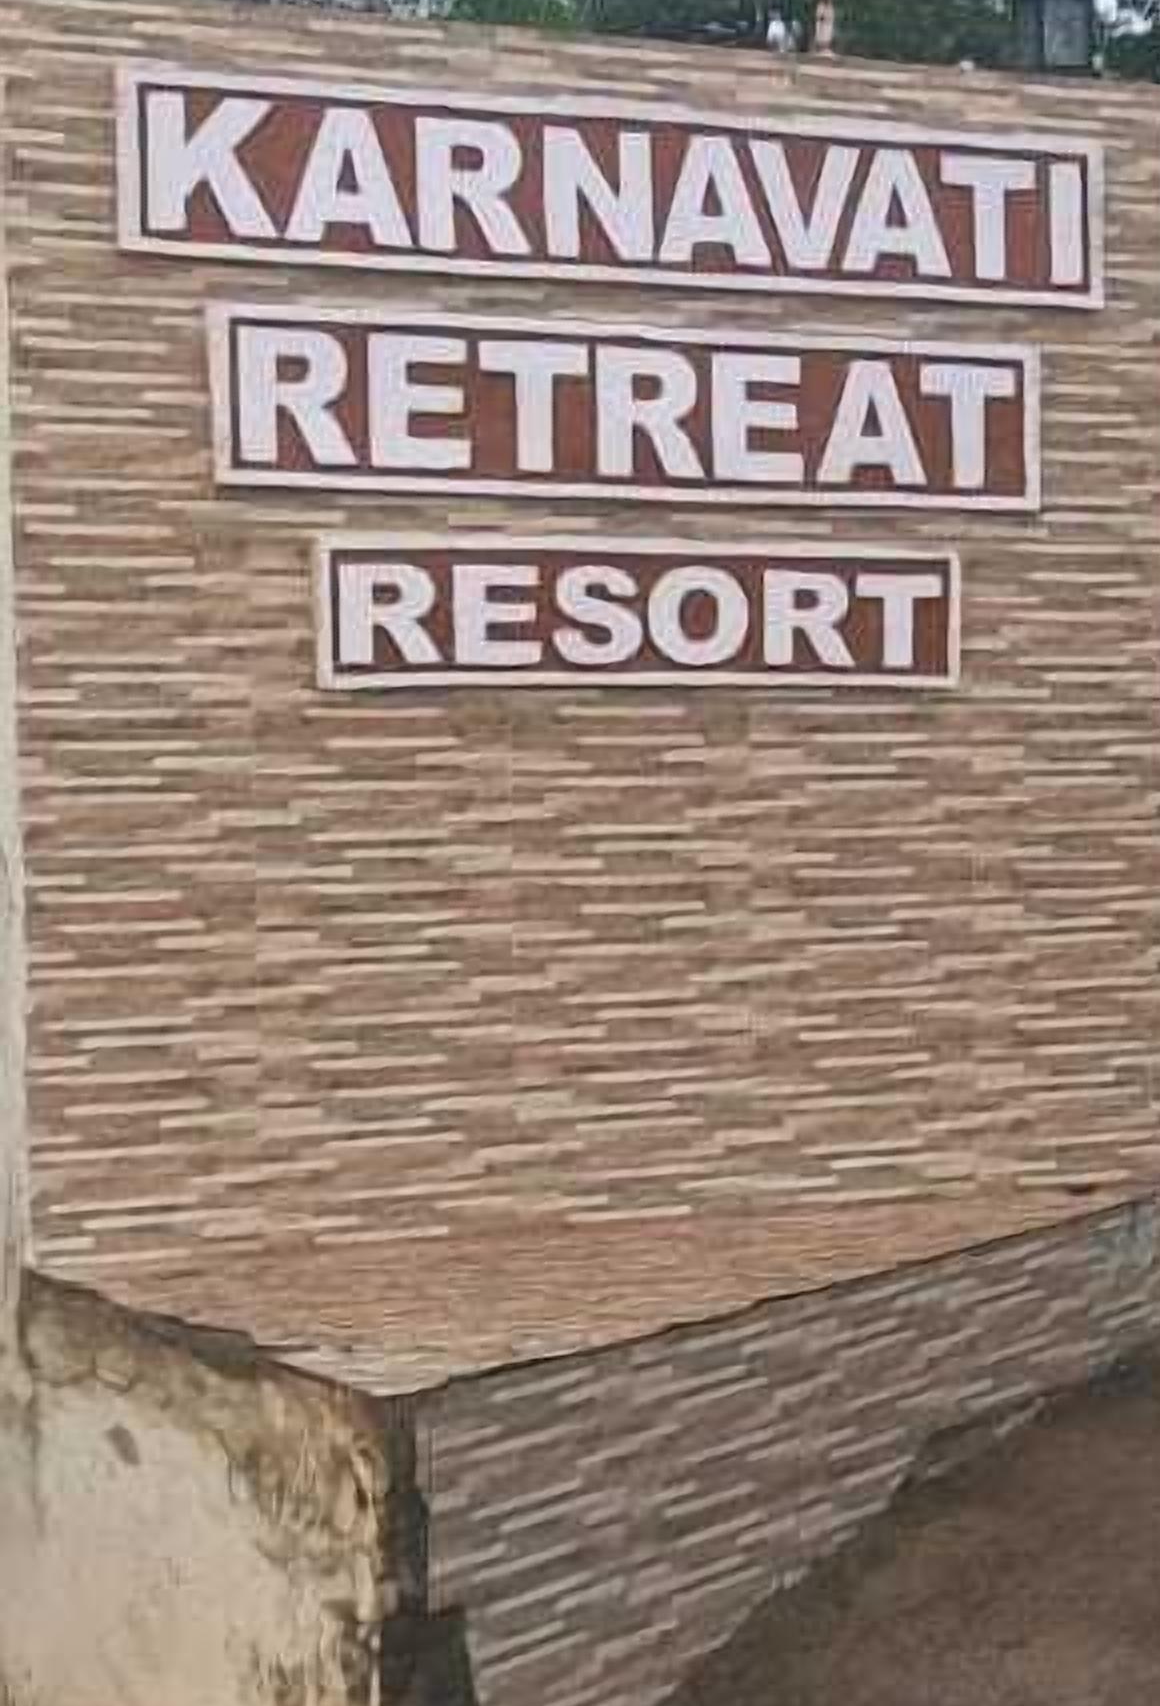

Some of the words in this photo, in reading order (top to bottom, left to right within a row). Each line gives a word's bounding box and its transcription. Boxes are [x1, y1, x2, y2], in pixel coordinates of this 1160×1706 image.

[144, 90, 1085, 286] KARNAVATI
[236, 324, 1015, 490] RETREAT
[336, 562, 943, 670] RESORT
